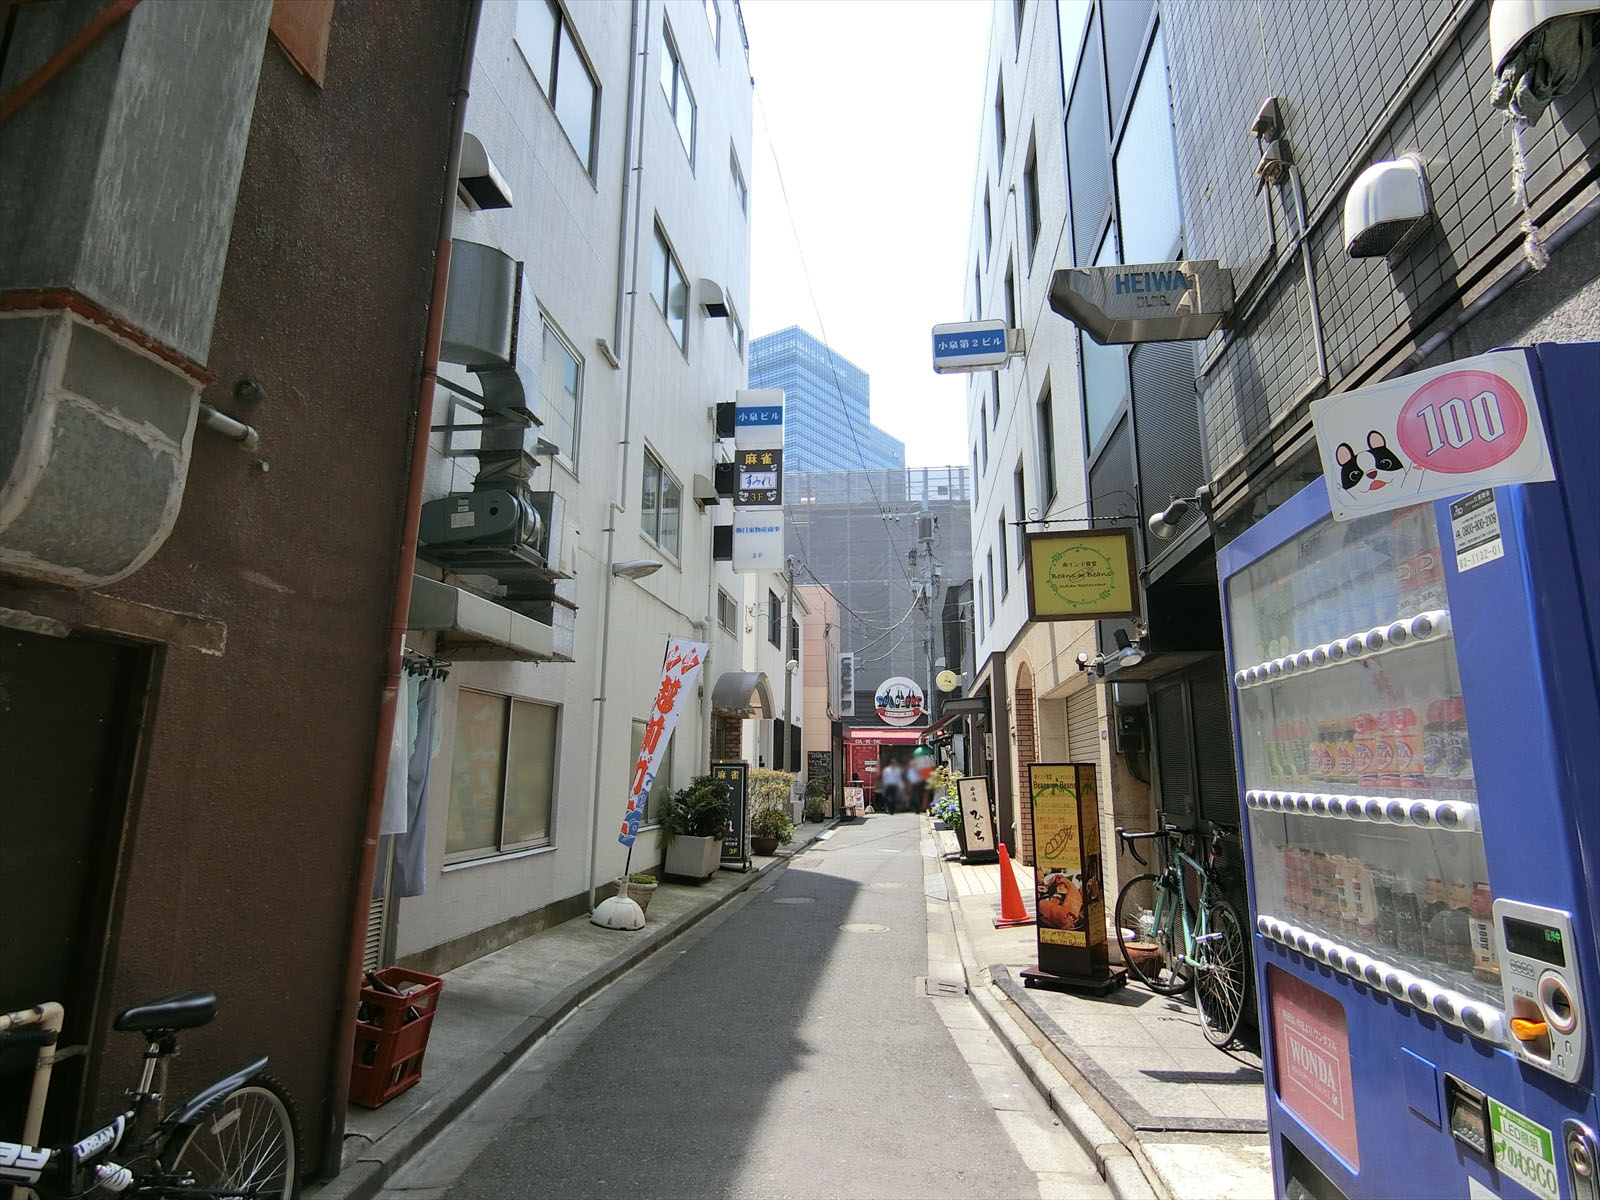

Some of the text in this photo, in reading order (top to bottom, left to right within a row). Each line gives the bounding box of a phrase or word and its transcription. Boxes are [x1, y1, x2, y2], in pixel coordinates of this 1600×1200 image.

[1115, 270, 1188, 295] HEIWA
[938, 337, 1002, 351] 小泉第2ビル
[738, 411, 780, 421] 小泉ビル
[1417, 391, 1505, 457] 100
[745, 452, 773, 465] 麻雀
[745, 474, 774, 489] すみれ
[751, 492, 764, 501] 3F
[717, 770, 740, 780] 麻雀
[1289, 1036, 1338, 1093] WONDA
